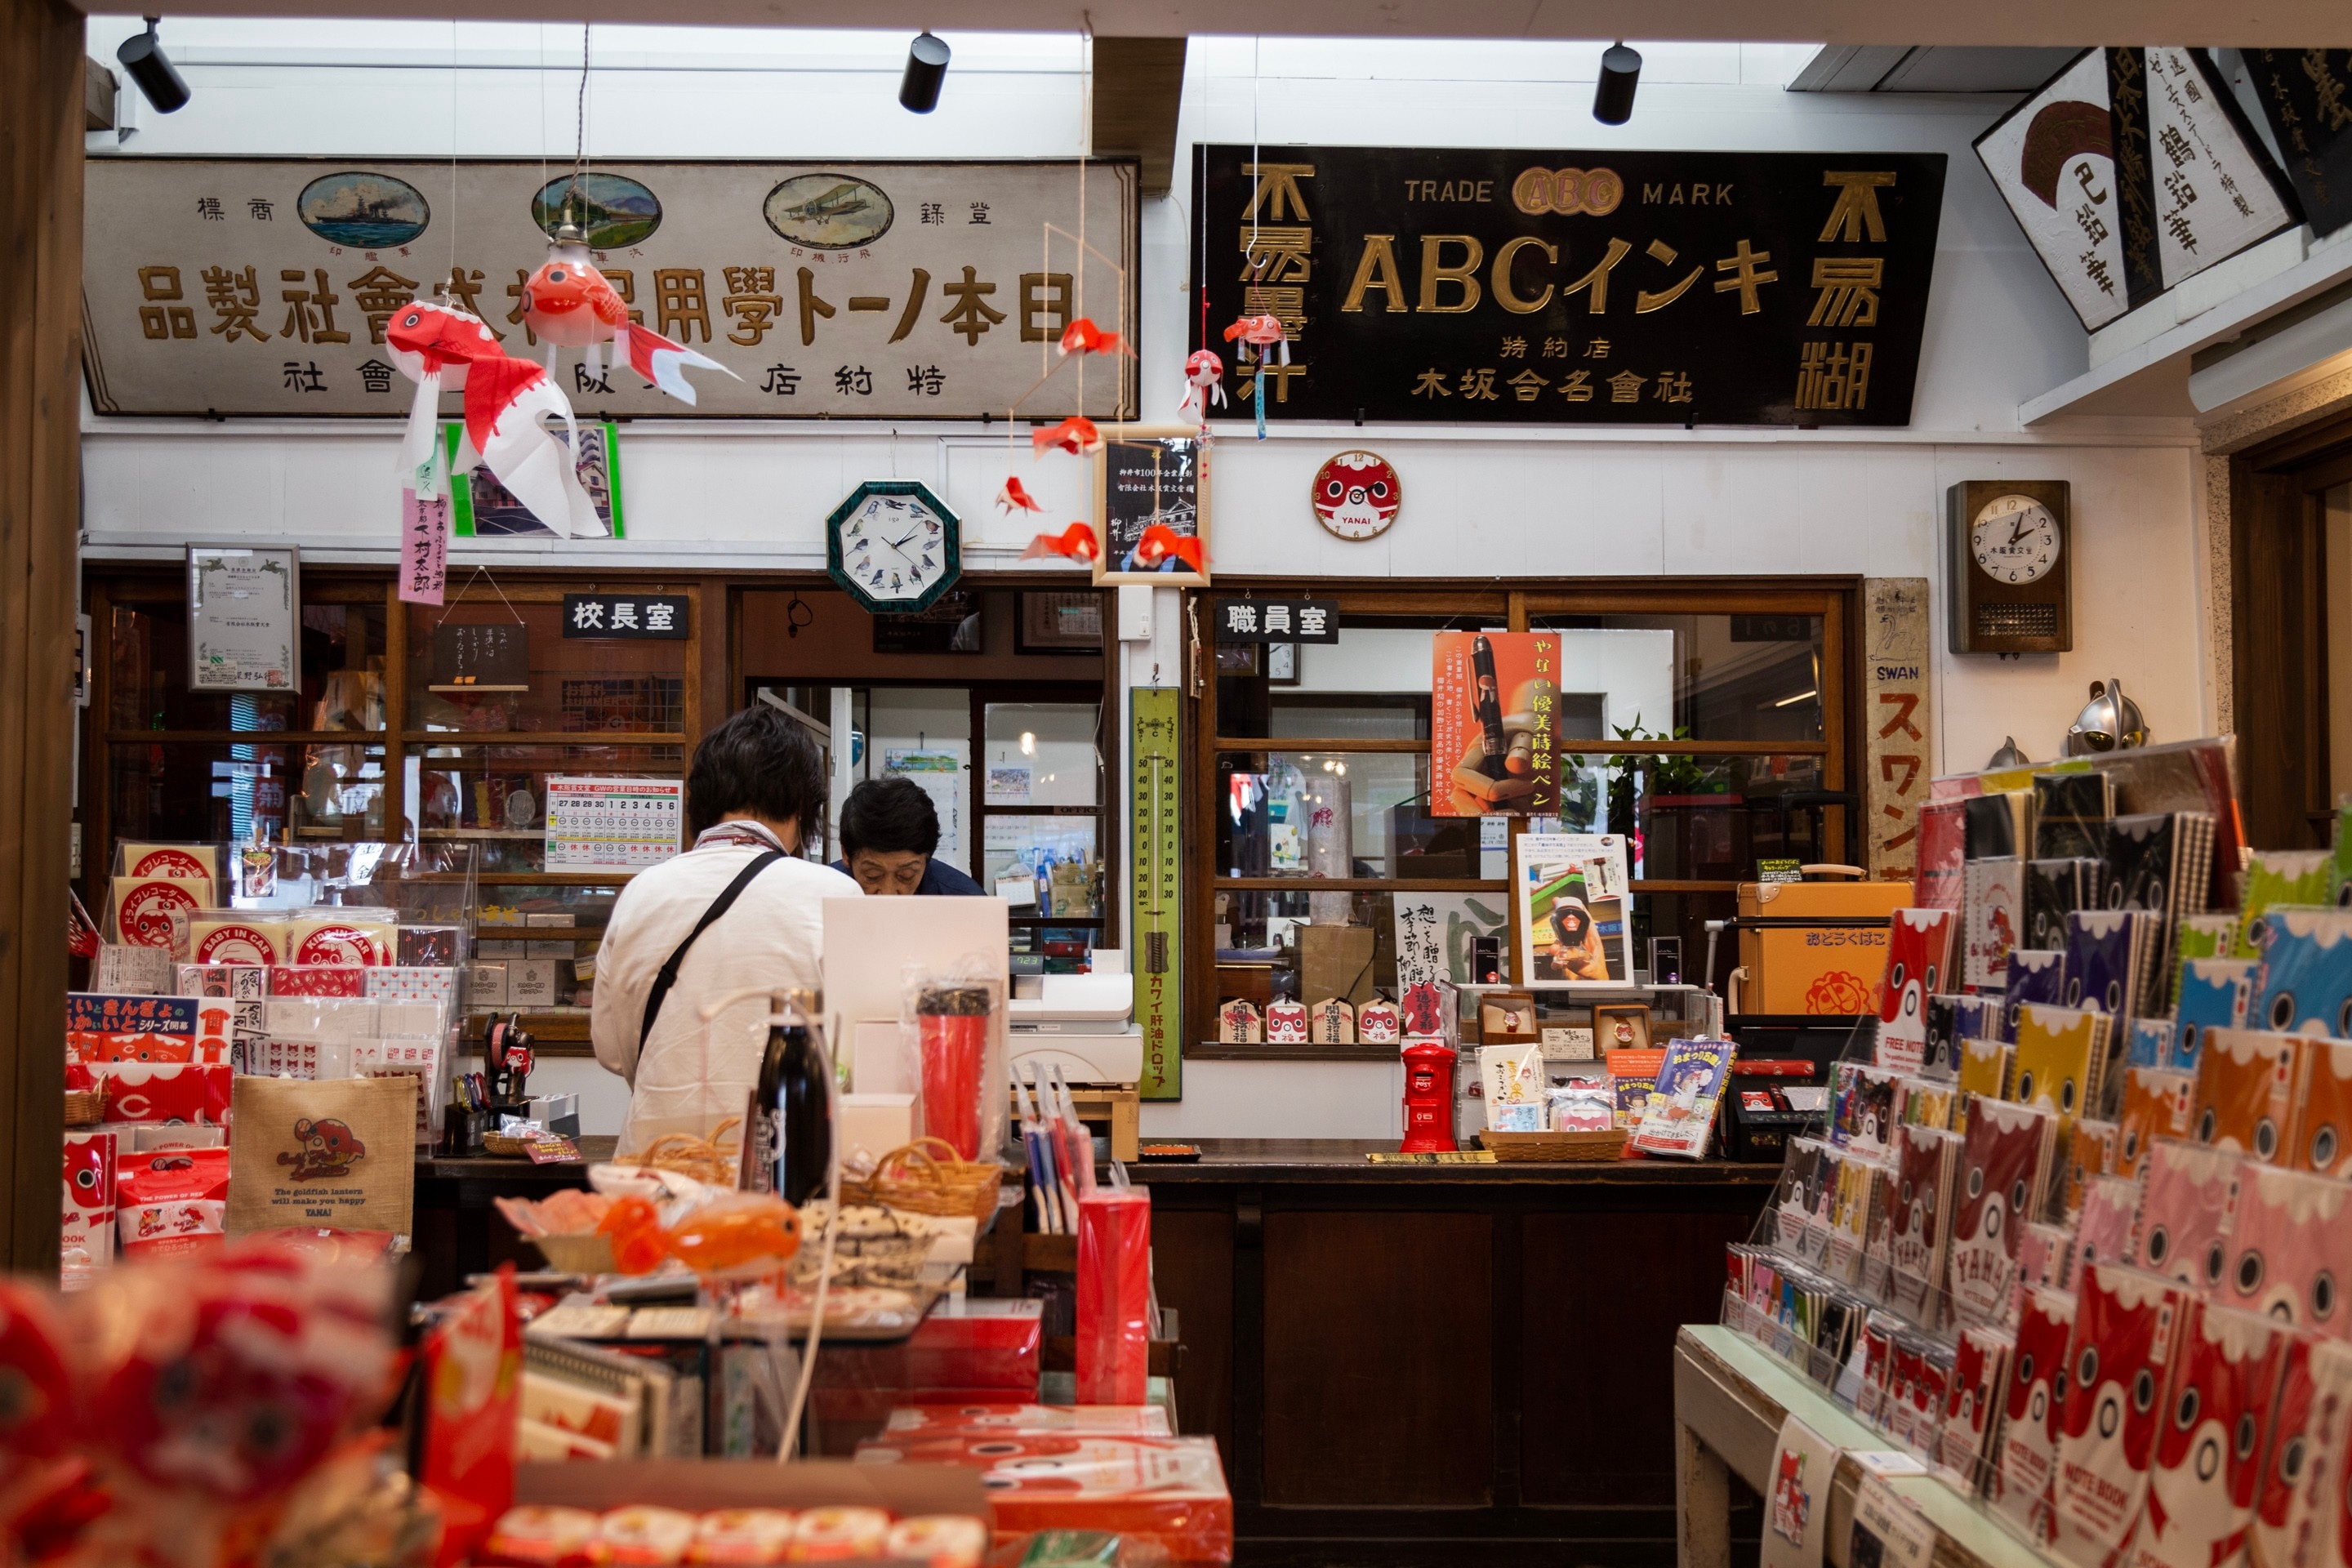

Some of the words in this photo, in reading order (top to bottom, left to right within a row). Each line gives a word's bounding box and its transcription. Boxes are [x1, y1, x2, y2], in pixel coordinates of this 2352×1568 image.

[1405, 179, 1494, 203] TRADE
[1526, 176, 1615, 207] ABC
[1642, 182, 1734, 206] MARK
[1340, 233, 1779, 315] ABCインキ
[1499, 335, 1612, 359] 特約店
[2007, 499, 2017, 510] 12
[1991, 506, 1998, 515] 11
[2028, 506, 2032, 515] 1
[1342, 516, 1370, 525] YANAI
[2039, 517, 2047, 528] 2
[1973, 535, 1982, 546] 9
[2043, 535, 2052, 546] 3
[1978, 553, 1986, 564] 8
[2038, 554, 2047, 564] 4
[1991, 566, 1999, 577] 7
[2010, 570, 2018, 582] 6
[2027, 566, 2036, 577] 5
[572, 601, 675, 631] 校長室
[1227, 604, 1327, 635] 職員室
[1877, 666, 1919, 681] SWAN
[1532, 639, 1552, 807] やない優美蒔絵ペン
[1138, 760, 1147, 768] 50
[1165, 760, 1174, 768] 50
[1138, 776, 1147, 784] 40
[1165, 776, 1174, 784] 40
[1138, 792, 1147, 800] 30
[1165, 792, 1174, 800] 30
[621, 801, 627, 809] 2
[644, 802, 651, 810] 4
[657, 802, 663, 810] 5
[668, 802, 675, 810] 6
[1138, 808, 1147, 817] 20
[1165, 808, 1174, 817] 20
[1139, 825, 1147, 833] 10
[1165, 825, 1174, 833] 10
[1143, 841, 1147, 849] 0
[1168, 841, 1174, 849] 0
[1139, 858, 1147, 866] 10
[1165, 858, 1174, 866] 10
[1138, 874, 1147, 882] 20
[1165, 874, 1174, 882] 20
[1138, 890, 1147, 898] 30
[1165, 890, 1174, 898] 30
[204, 929, 231, 952] BABY
[234, 929, 247, 938] IN
[250, 932, 270, 956] CAR
[1149, 976, 1165, 1089] カワイ肝油ドロップ
[1884, 1036, 1905, 1051] FREE
[1905, 1040, 1925, 1054] NOTE
[1415, 1080, 1432, 1089] POST
[293, 1188, 328, 1197] goldfish
[338, 1197, 366, 1205] happy
[306, 1209, 332, 1217] YANAI
